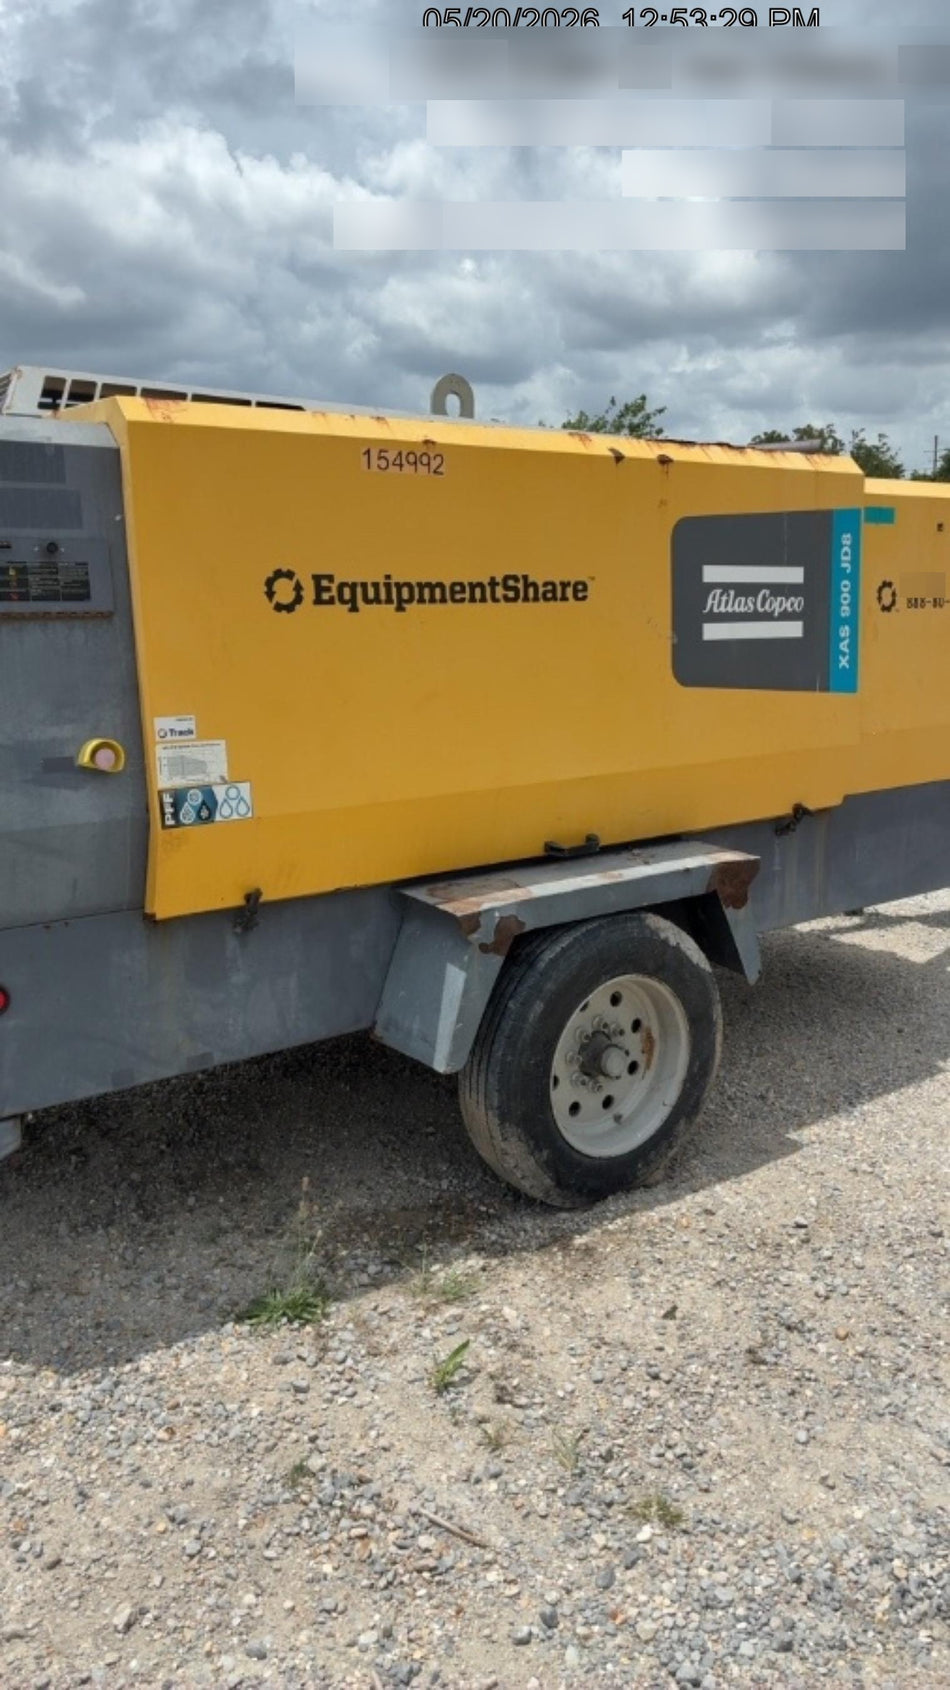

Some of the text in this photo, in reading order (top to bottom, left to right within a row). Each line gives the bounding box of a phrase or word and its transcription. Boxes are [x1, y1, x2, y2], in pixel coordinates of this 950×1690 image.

[362, 448, 445, 476] 154992
[703, 589, 805, 618] Atlas Copco
[839, 533, 853, 669] XAS 900 JD8
[163, 792, 175, 825] PFF
